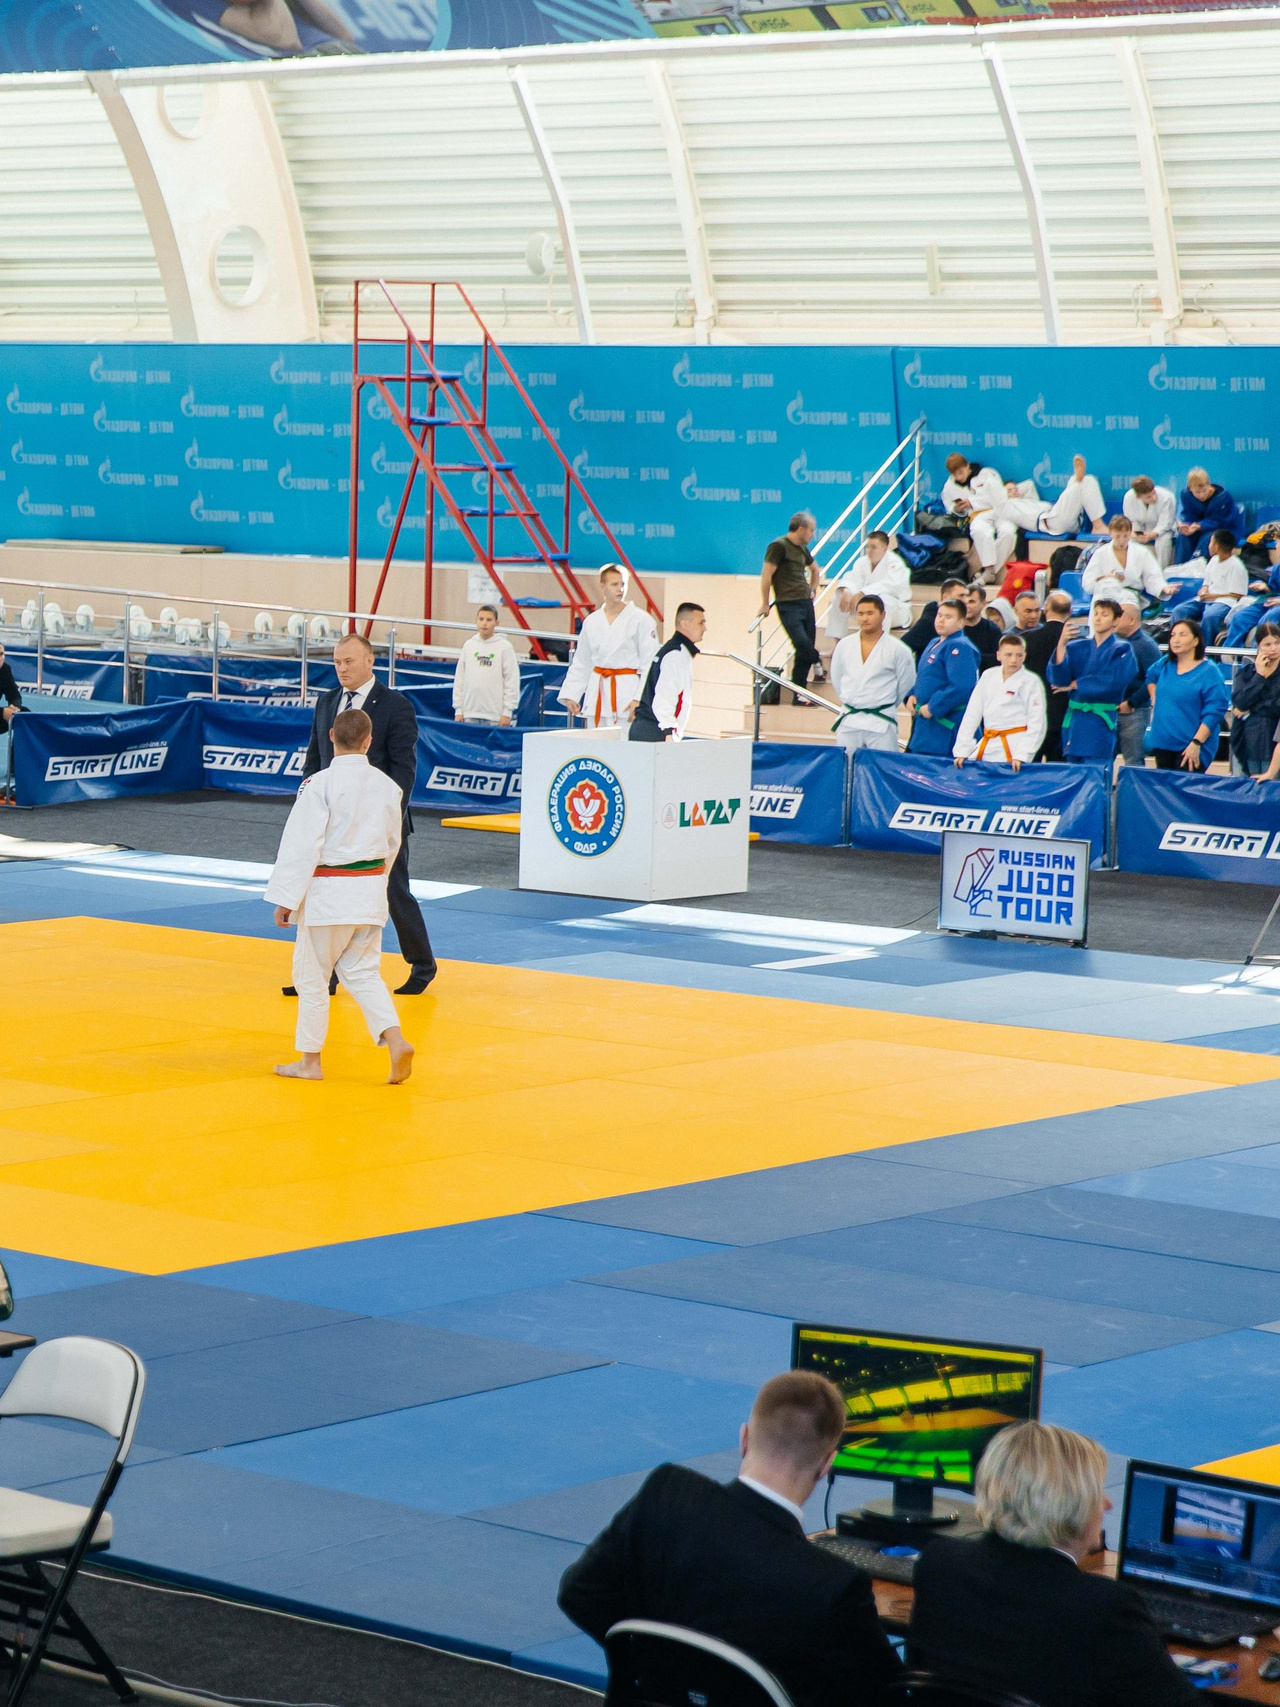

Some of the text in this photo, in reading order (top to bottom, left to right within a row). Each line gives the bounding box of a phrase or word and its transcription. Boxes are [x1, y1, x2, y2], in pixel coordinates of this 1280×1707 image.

[751, 17, 790, 31] OMEGA
[50, 752, 161, 776] START LINE
[204, 750, 280, 769] START
[433, 770, 502, 791] START
[550, 760, 624, 838] ФЕДЕРАЦИЯ ДЗЮДО РОССИИ
[1001, 804, 1060, 815] www.start-line.ru
[897, 808, 1050, 836] START LINE
[573, 841, 598, 854] ФДР
[1167, 829, 1263, 852] START
[999, 849, 1075, 870] RUSSIAN
[997, 869, 1074, 898] JUDO
[997, 895, 1073, 926] TOUR
